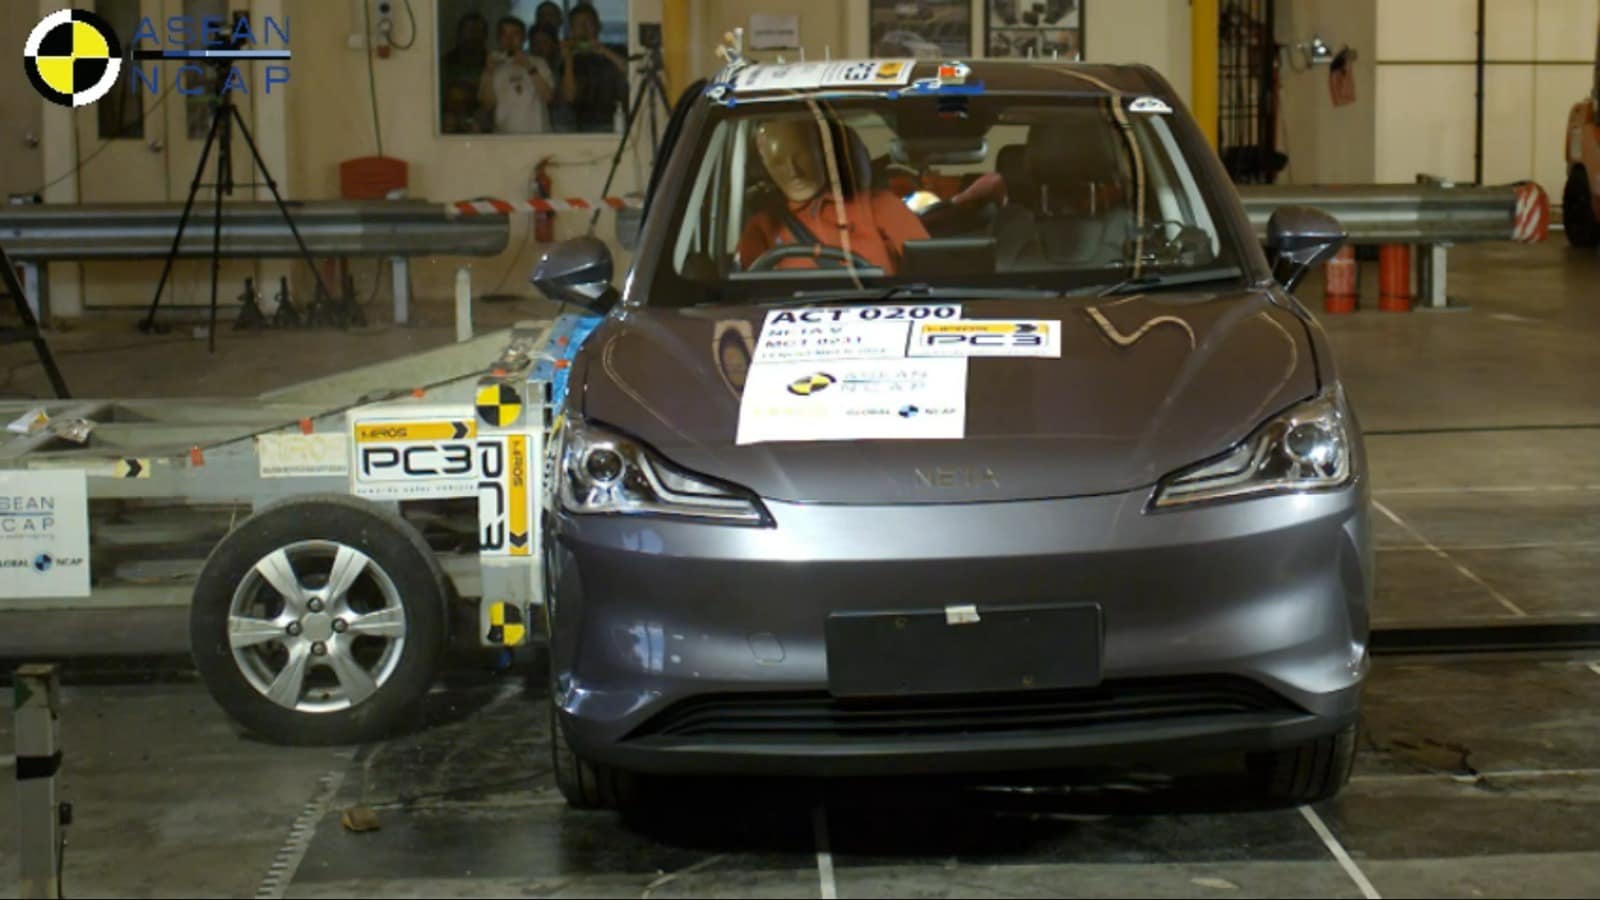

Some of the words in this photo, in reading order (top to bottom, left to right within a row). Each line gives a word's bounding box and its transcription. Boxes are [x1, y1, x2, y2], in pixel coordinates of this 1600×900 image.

[770, 309, 849, 325] ACT
[858, 305, 957, 321] 0200
[926, 333, 1042, 347] PC3
[362, 444, 473, 477] PC3
[914, 465, 1000, 489] NETA
[476, 441, 504, 551] PC3
[1, 516, 55, 533] CAP
